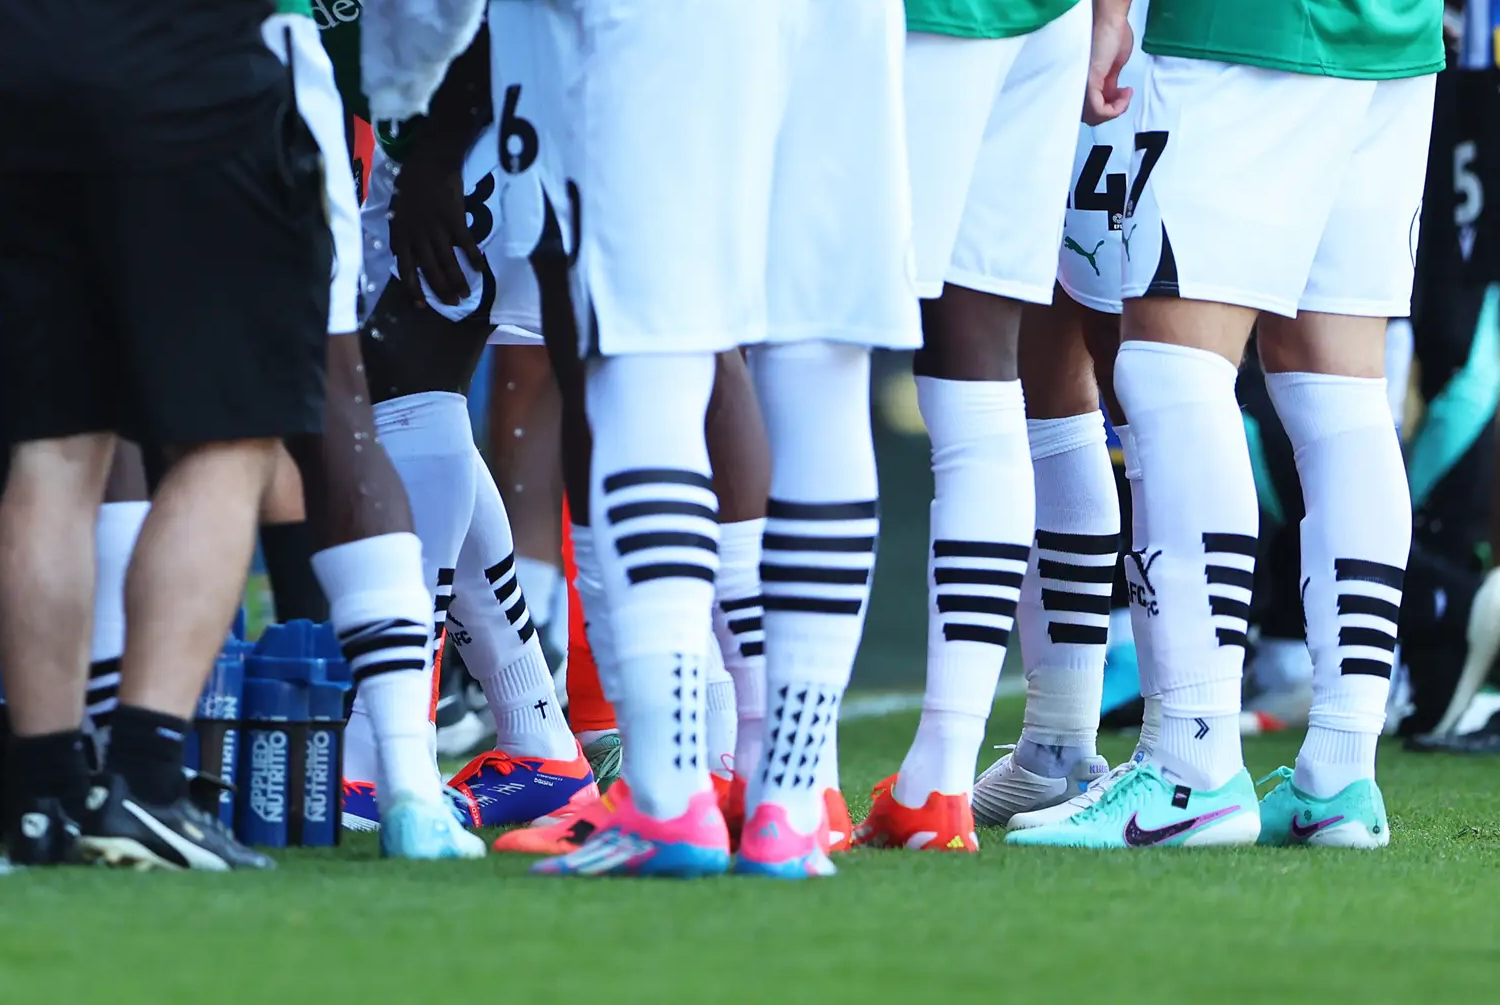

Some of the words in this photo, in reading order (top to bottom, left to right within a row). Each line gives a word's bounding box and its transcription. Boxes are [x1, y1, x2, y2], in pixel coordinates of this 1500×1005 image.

[498, 83, 540, 174] 6
[1064, 144, 1127, 231] 4
[1453, 140, 1485, 225] 5
[268, 715, 287, 822] NUTRITIO
[313, 715, 330, 822] NUTRITIO
